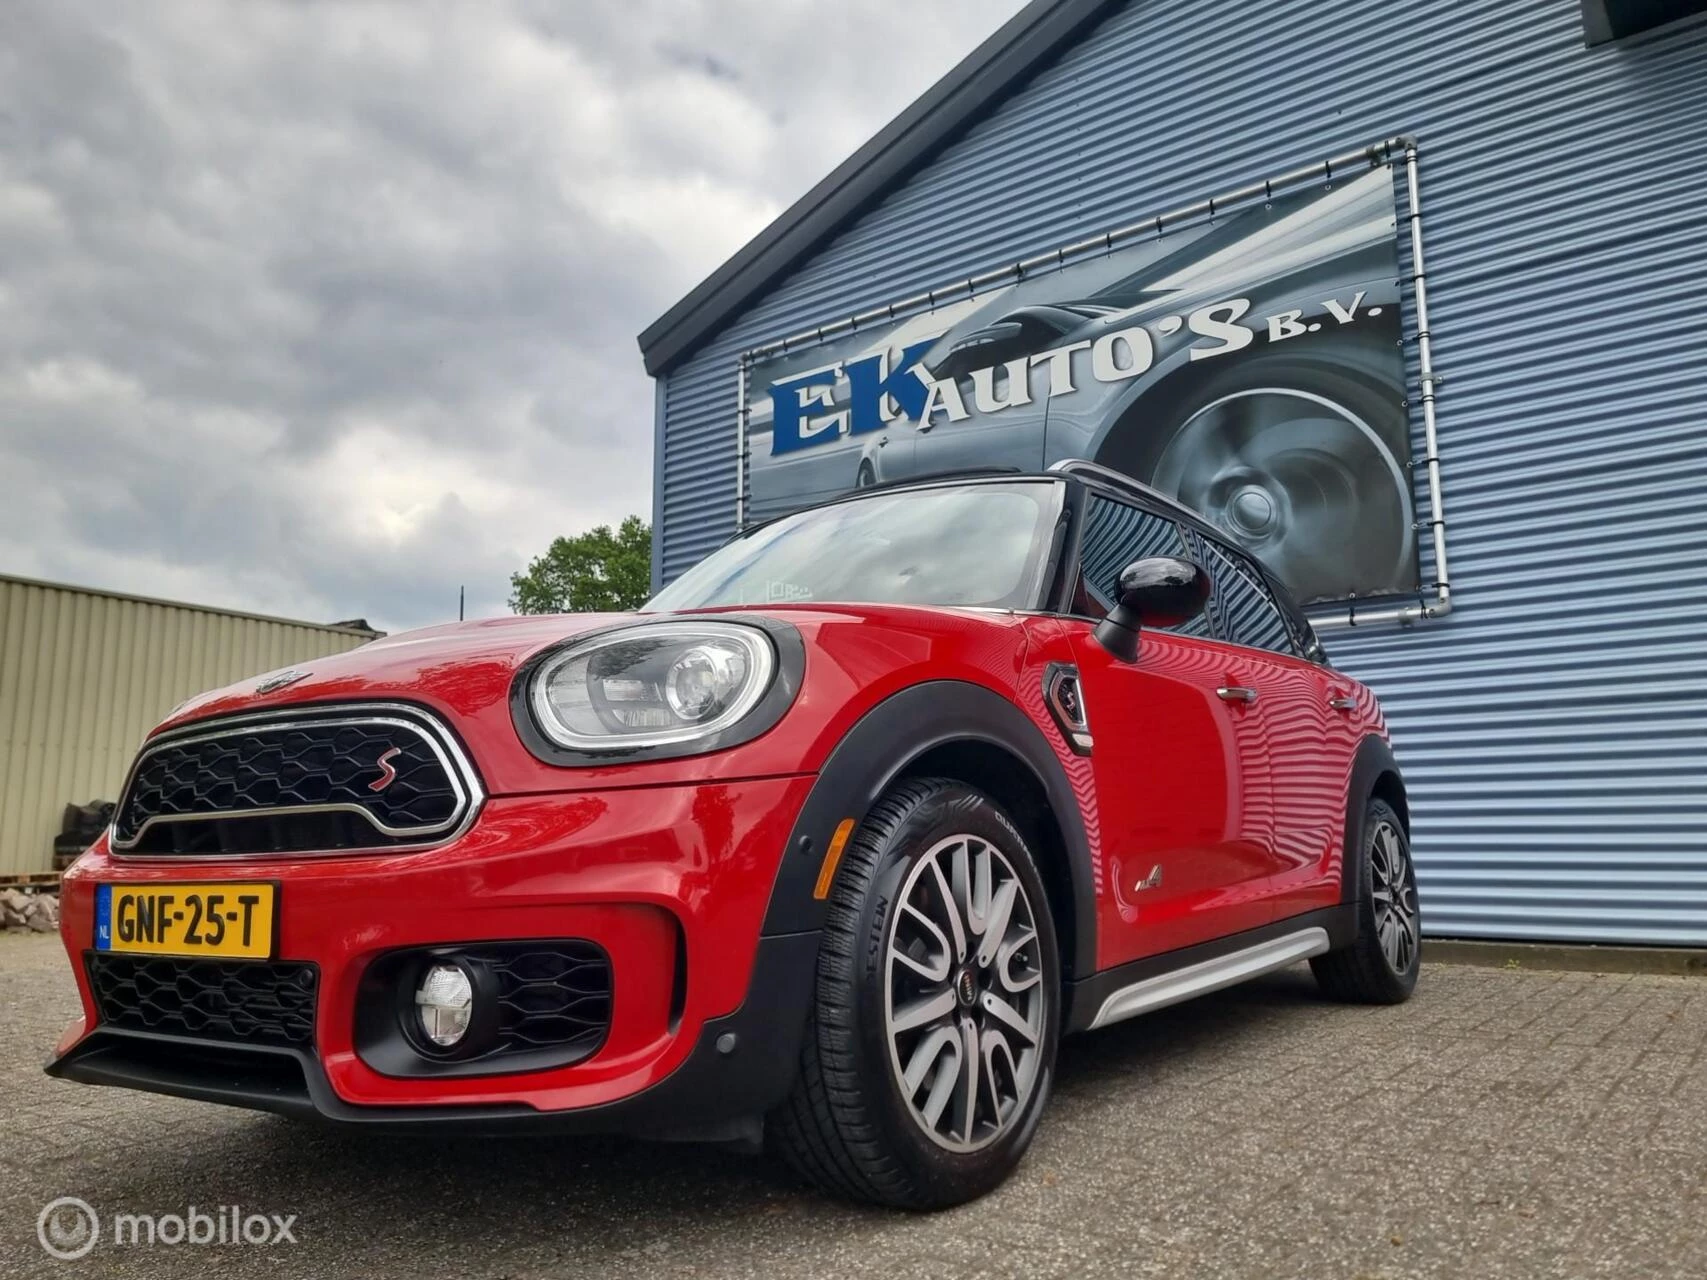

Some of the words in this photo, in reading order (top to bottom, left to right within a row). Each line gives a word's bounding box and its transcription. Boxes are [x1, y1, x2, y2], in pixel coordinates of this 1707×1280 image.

[768, 329, 950, 456] EK
[916, 298, 1254, 431] AUTO'S
[1265, 291, 1383, 342] B.V.
[100, 925, 109, 939] NL
[117, 894, 259, 947] GNF-25-T
